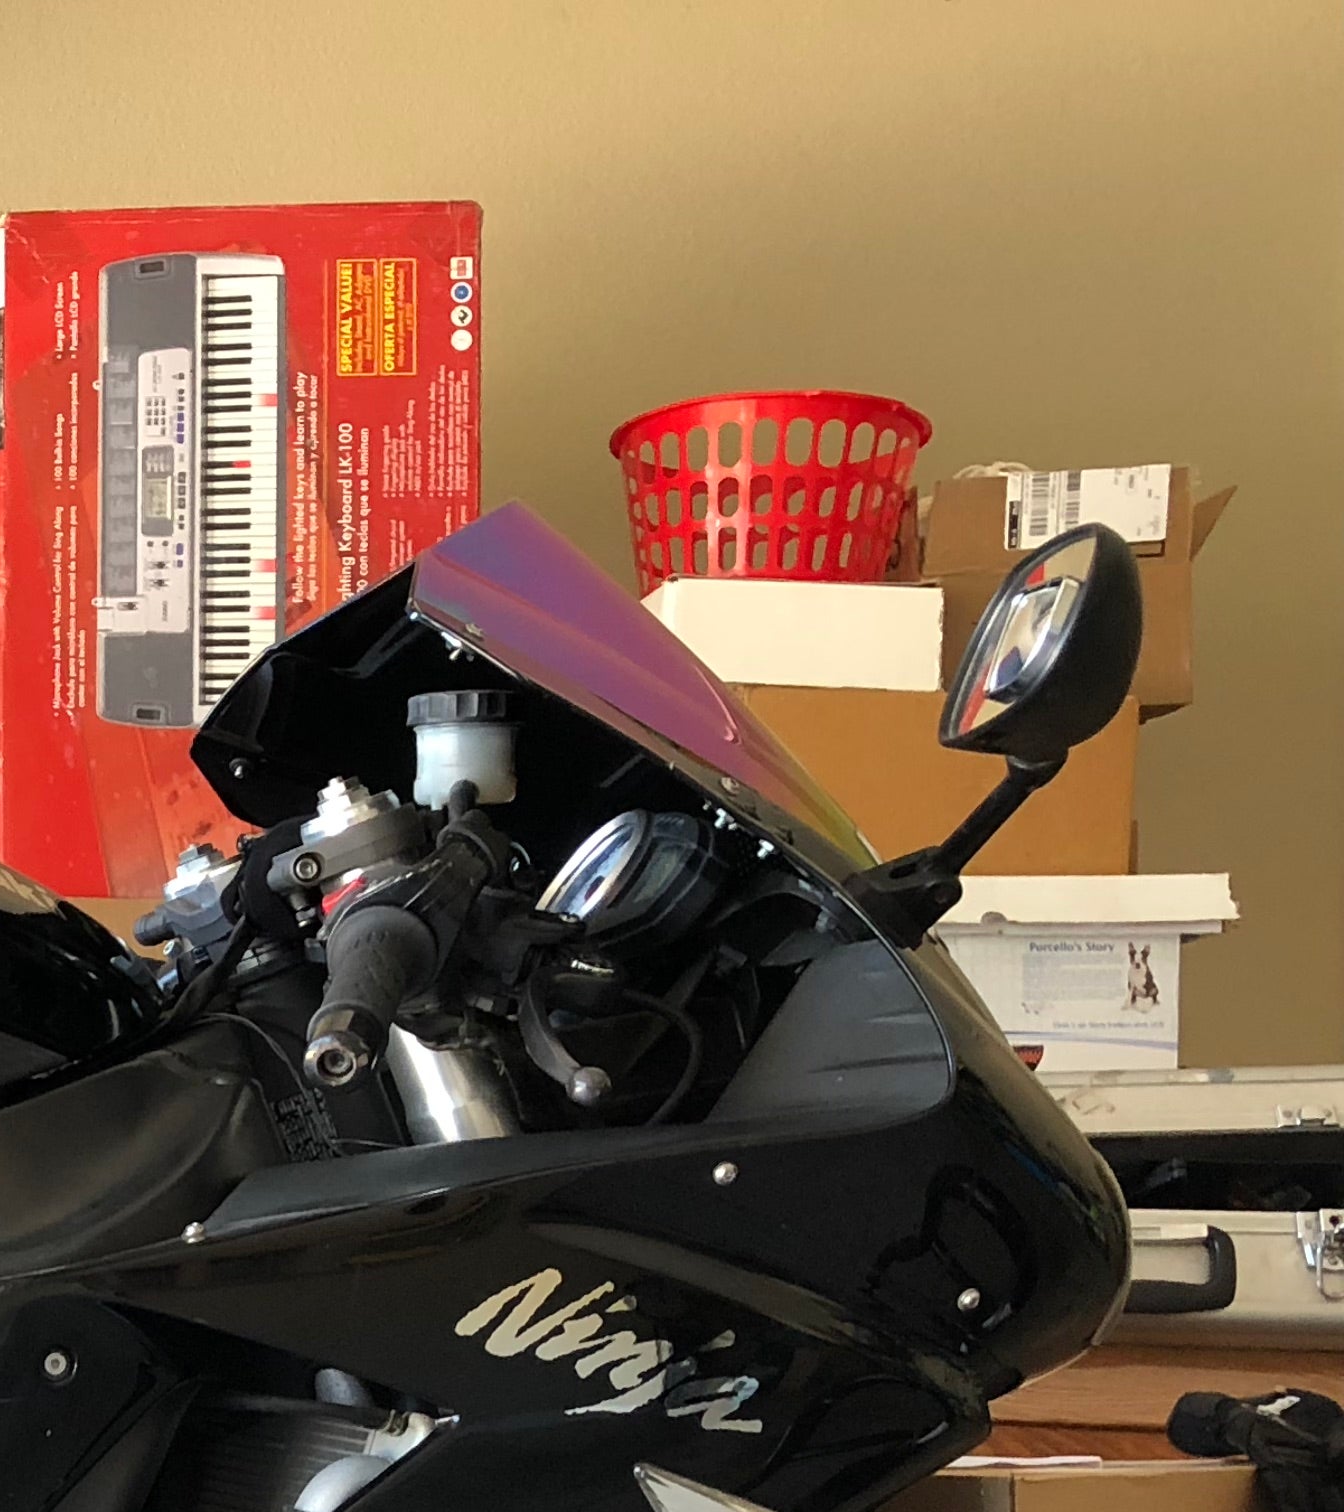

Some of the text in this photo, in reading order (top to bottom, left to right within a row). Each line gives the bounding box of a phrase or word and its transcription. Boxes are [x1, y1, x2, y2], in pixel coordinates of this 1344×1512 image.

[55, 283, 64, 351] Large LCD Screen
[69, 301, 78, 318] LCD
[340, 263, 352, 372] SPECIAL VALUE!
[384, 263, 395, 371] OFERTA ESPECIAL
[309, 375, 318, 399] tocar
[338, 423, 353, 474] LK-100
[357, 428, 369, 475] iluminan
[55, 466, 63, 481] 100
[293, 373, 308, 603] Follow the lighted keys and learn to play
[338, 479, 355, 551] Keyboard
[359, 496, 371, 516] que
[357, 520, 368, 552] teclas
[53, 564, 62, 593] Control
[359, 556, 368, 576] con
[53, 626, 61, 641] with
[1086, 942, 1115, 953] Story
[454, 1267, 764, 1434] Ninja
